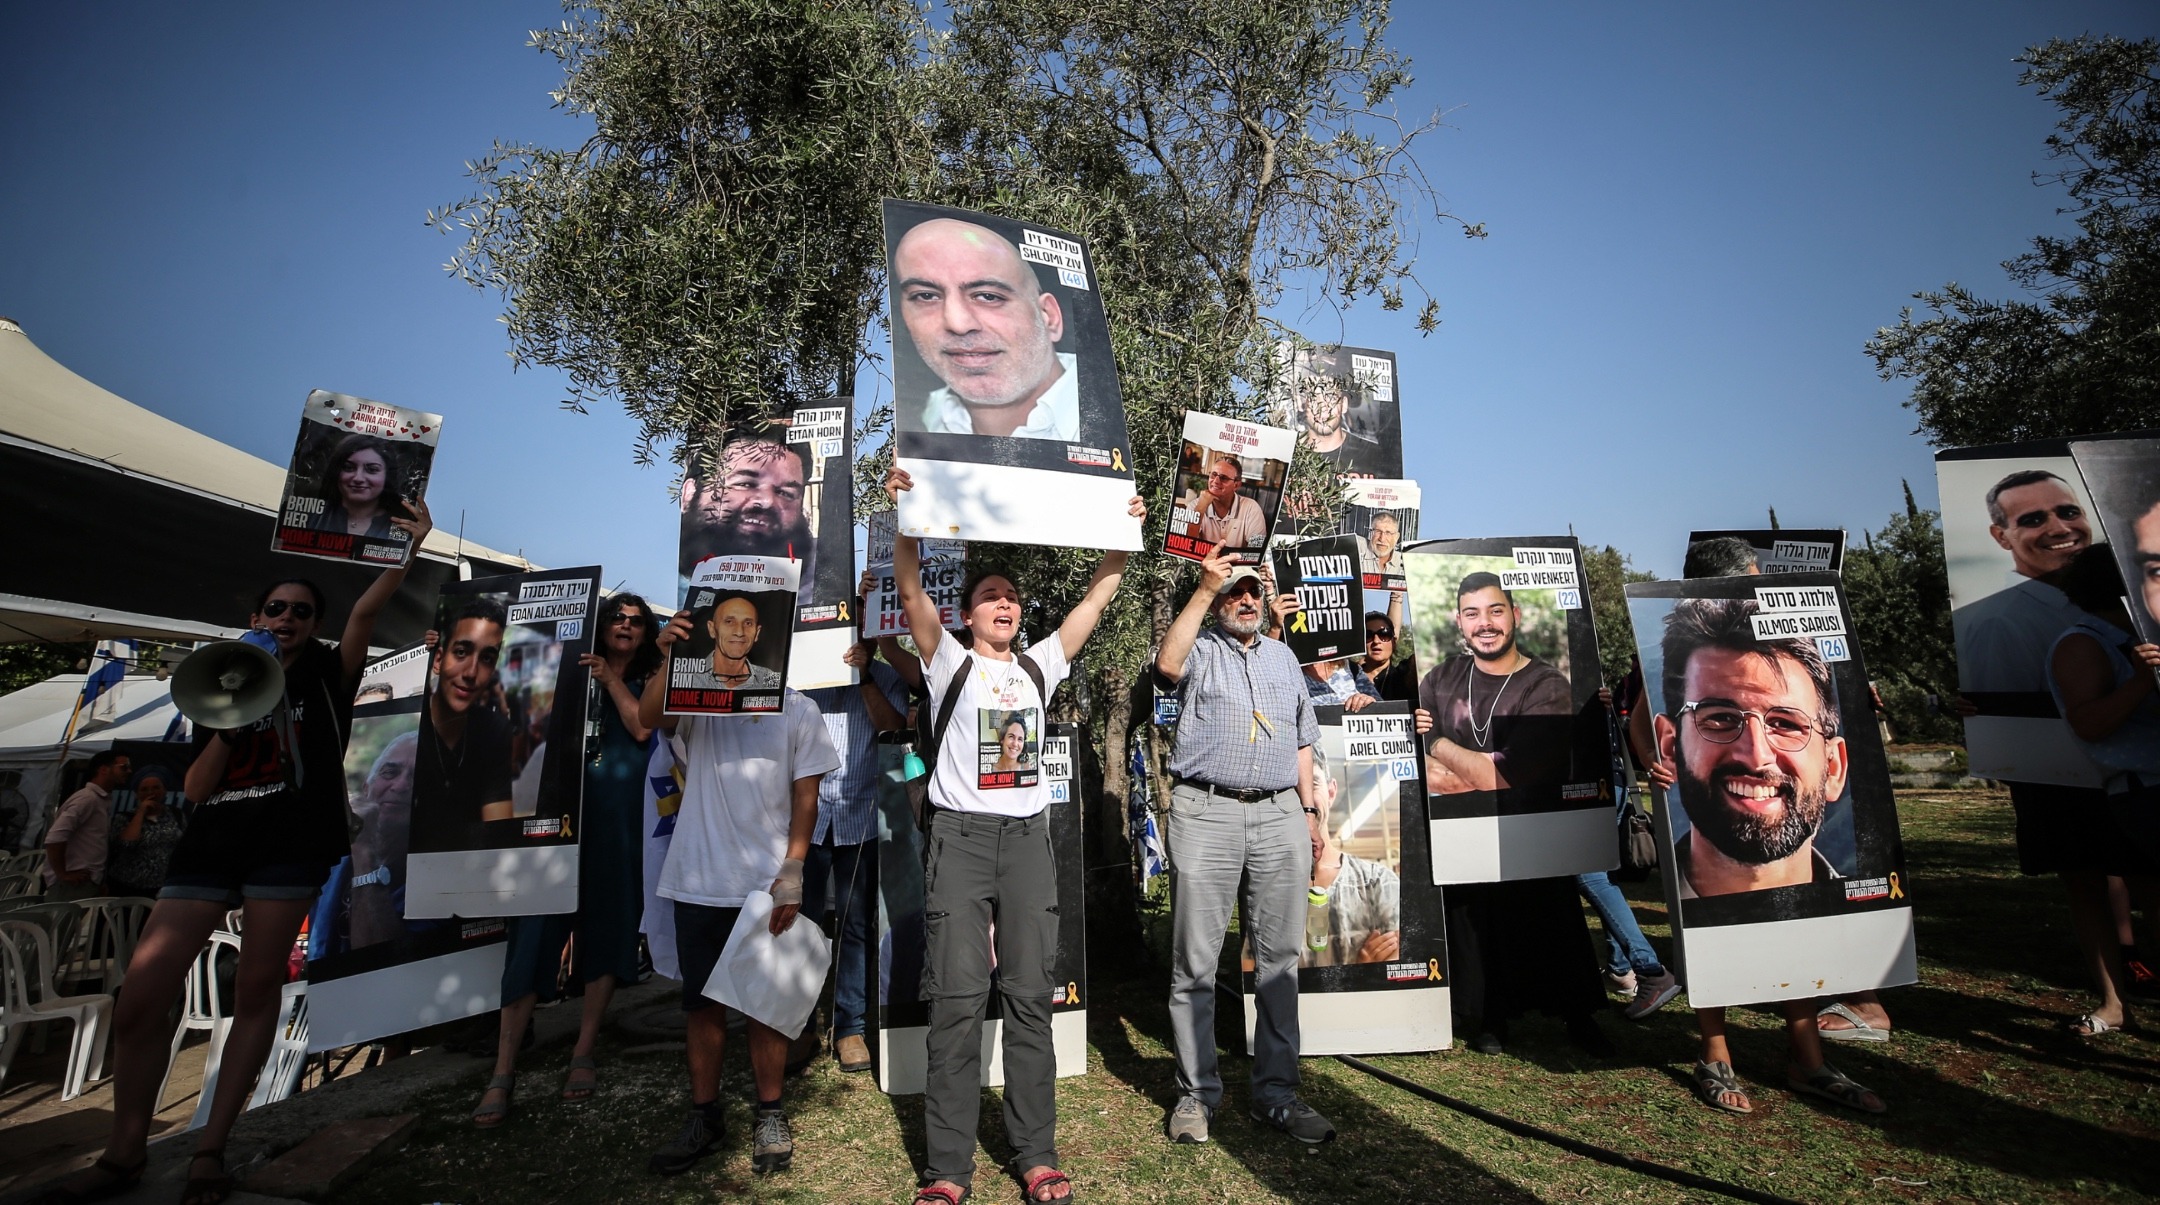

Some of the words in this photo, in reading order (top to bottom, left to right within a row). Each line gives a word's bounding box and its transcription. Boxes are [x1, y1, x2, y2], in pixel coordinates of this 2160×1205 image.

[1027, 232, 1042, 245] זיו
[1045, 239, 1079, 255] שלומי
[1023, 247, 1063, 266] SHLOMI
[1066, 257, 1081, 270] ZIV
[1061, 271, 1086, 289] (48)
[1381, 374, 1391, 385] OZ
[351, 411, 377, 425] KARINA
[378, 417, 398, 429] ARIEV
[797, 411, 817, 424] הורן
[820, 410, 842, 423] איתן
[365, 424, 379, 434] (19)
[788, 428, 814, 441] EITAN
[817, 425, 842, 438] HORN
[1219, 432, 1235, 442] OHAD
[1235, 434, 1247, 445] BEN
[1247, 437, 1259, 448] AMI
[1231, 442, 1243, 454] (55)
[820, 441, 840, 457] (37)
[286, 495, 326, 515] BRING
[282, 511, 309, 529] HER
[1172, 506, 1200, 525] BRING
[1170, 520, 1188, 536] HIM
[281, 527, 316, 546] HOME
[317, 530, 353, 551] NOW!
[1167, 534, 1194, 552] HOME
[1194, 540, 1215, 555] NOW
[1516, 551, 1546, 566] ונקרט
[1547, 551, 1573, 566] עומר
[1775, 543, 1803, 560] גולדין
[1807, 546, 1831, 561] אורן
[1299, 555, 1353, 578] מנצחים
[881, 569, 954, 593] BNG
[1502, 573, 1530, 587] OMER
[1531, 571, 1576, 586] WENKERT
[522, 582, 565, 599] אלכסנדר
[567, 582, 588, 598] עידן
[1294, 584, 1348, 610] כשכולם
[1799, 589, 1836, 607] אלמוג
[880, 588, 954, 612] HSH
[1558, 590, 1579, 609] (22)
[1759, 592, 1797, 608] סרוסי
[511, 606, 534, 622] EDAN
[534, 602, 586, 619] ALEXANDER
[1307, 608, 1352, 633] חוזרים
[558, 621, 580, 640] (20)
[1758, 618, 1799, 636] ALMOG
[1801, 615, 1841, 635] SARUSI
[1820, 637, 1846, 660] (26)
[673, 658, 706, 674] BRING
[671, 673, 694, 688] HIM
[670, 690, 700, 705] HOME
[702, 691, 733, 707] NOW!
[1347, 719, 1374, 735] קוניו
[1376, 716, 1413, 733] אריאל
[1350, 742, 1379, 757] ARIEL
[1381, 740, 1413, 755] CUNIO
[981, 753, 1000, 764] BRING
[980, 763, 992, 774] HER
[1045, 762, 1068, 777] REN
[1391, 760, 1415, 780] (26)
[980, 774, 997, 785] HOME
[997, 772, 1015, 784] NOW!
